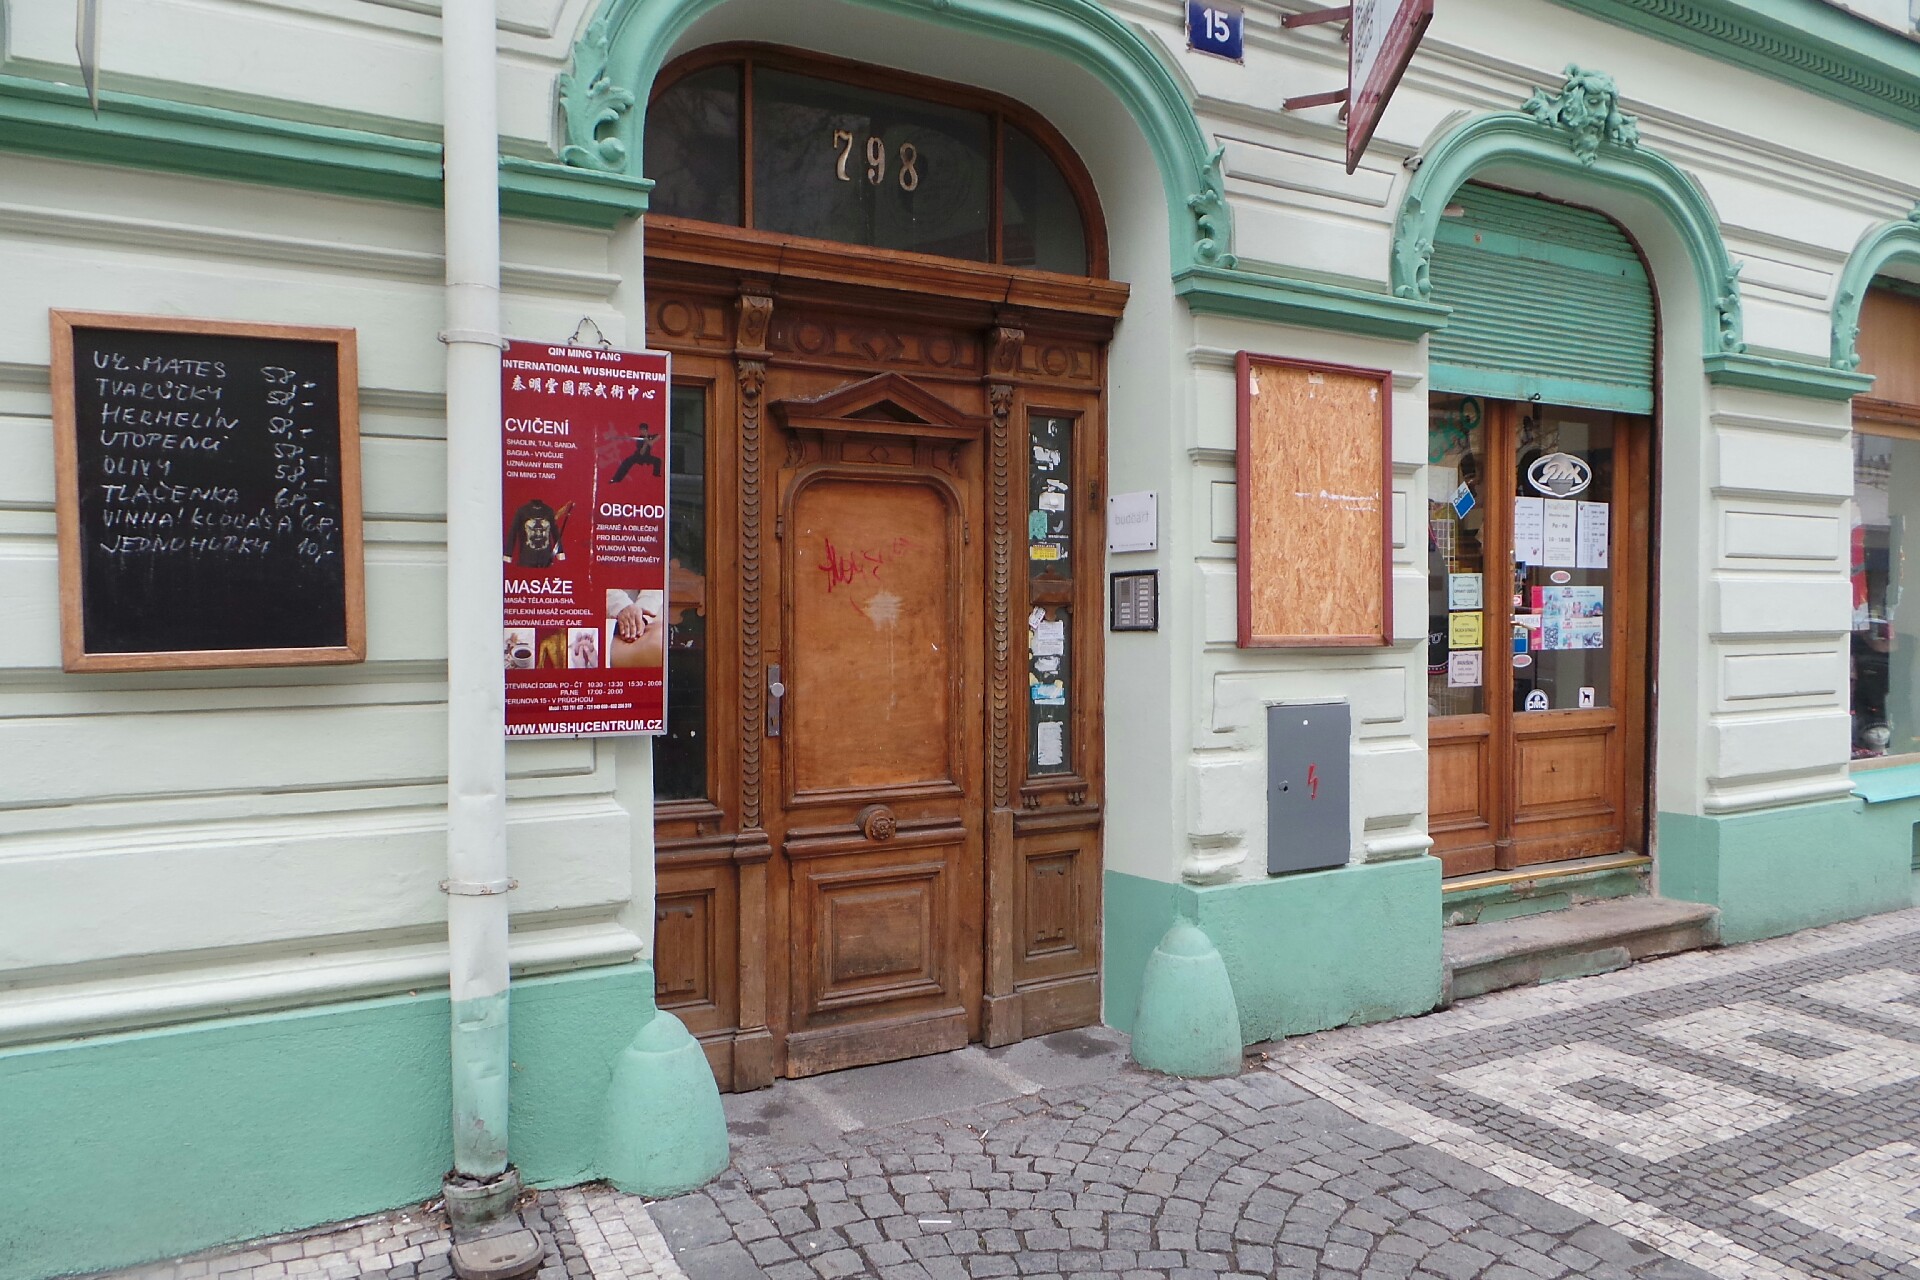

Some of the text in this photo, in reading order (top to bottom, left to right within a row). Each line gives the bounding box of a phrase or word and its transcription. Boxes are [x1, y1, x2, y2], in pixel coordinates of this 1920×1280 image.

[1203, 8, 1230, 42] 15
[833, 129, 918, 191] 798
[548, 347, 621, 362] QIN MING TANG
[502, 359, 666, 382] INTERNATIONAL WUSHUCENTRUM
[505, 417, 569, 436] CVIČENÍ
[538, 472, 556, 480] TANG
[600, 502, 664, 519] OBCHOD
[504, 577, 572, 594] MASÁŽE
[505, 720, 663, 735] WWW.WUSHUCENTRUM.CZ
